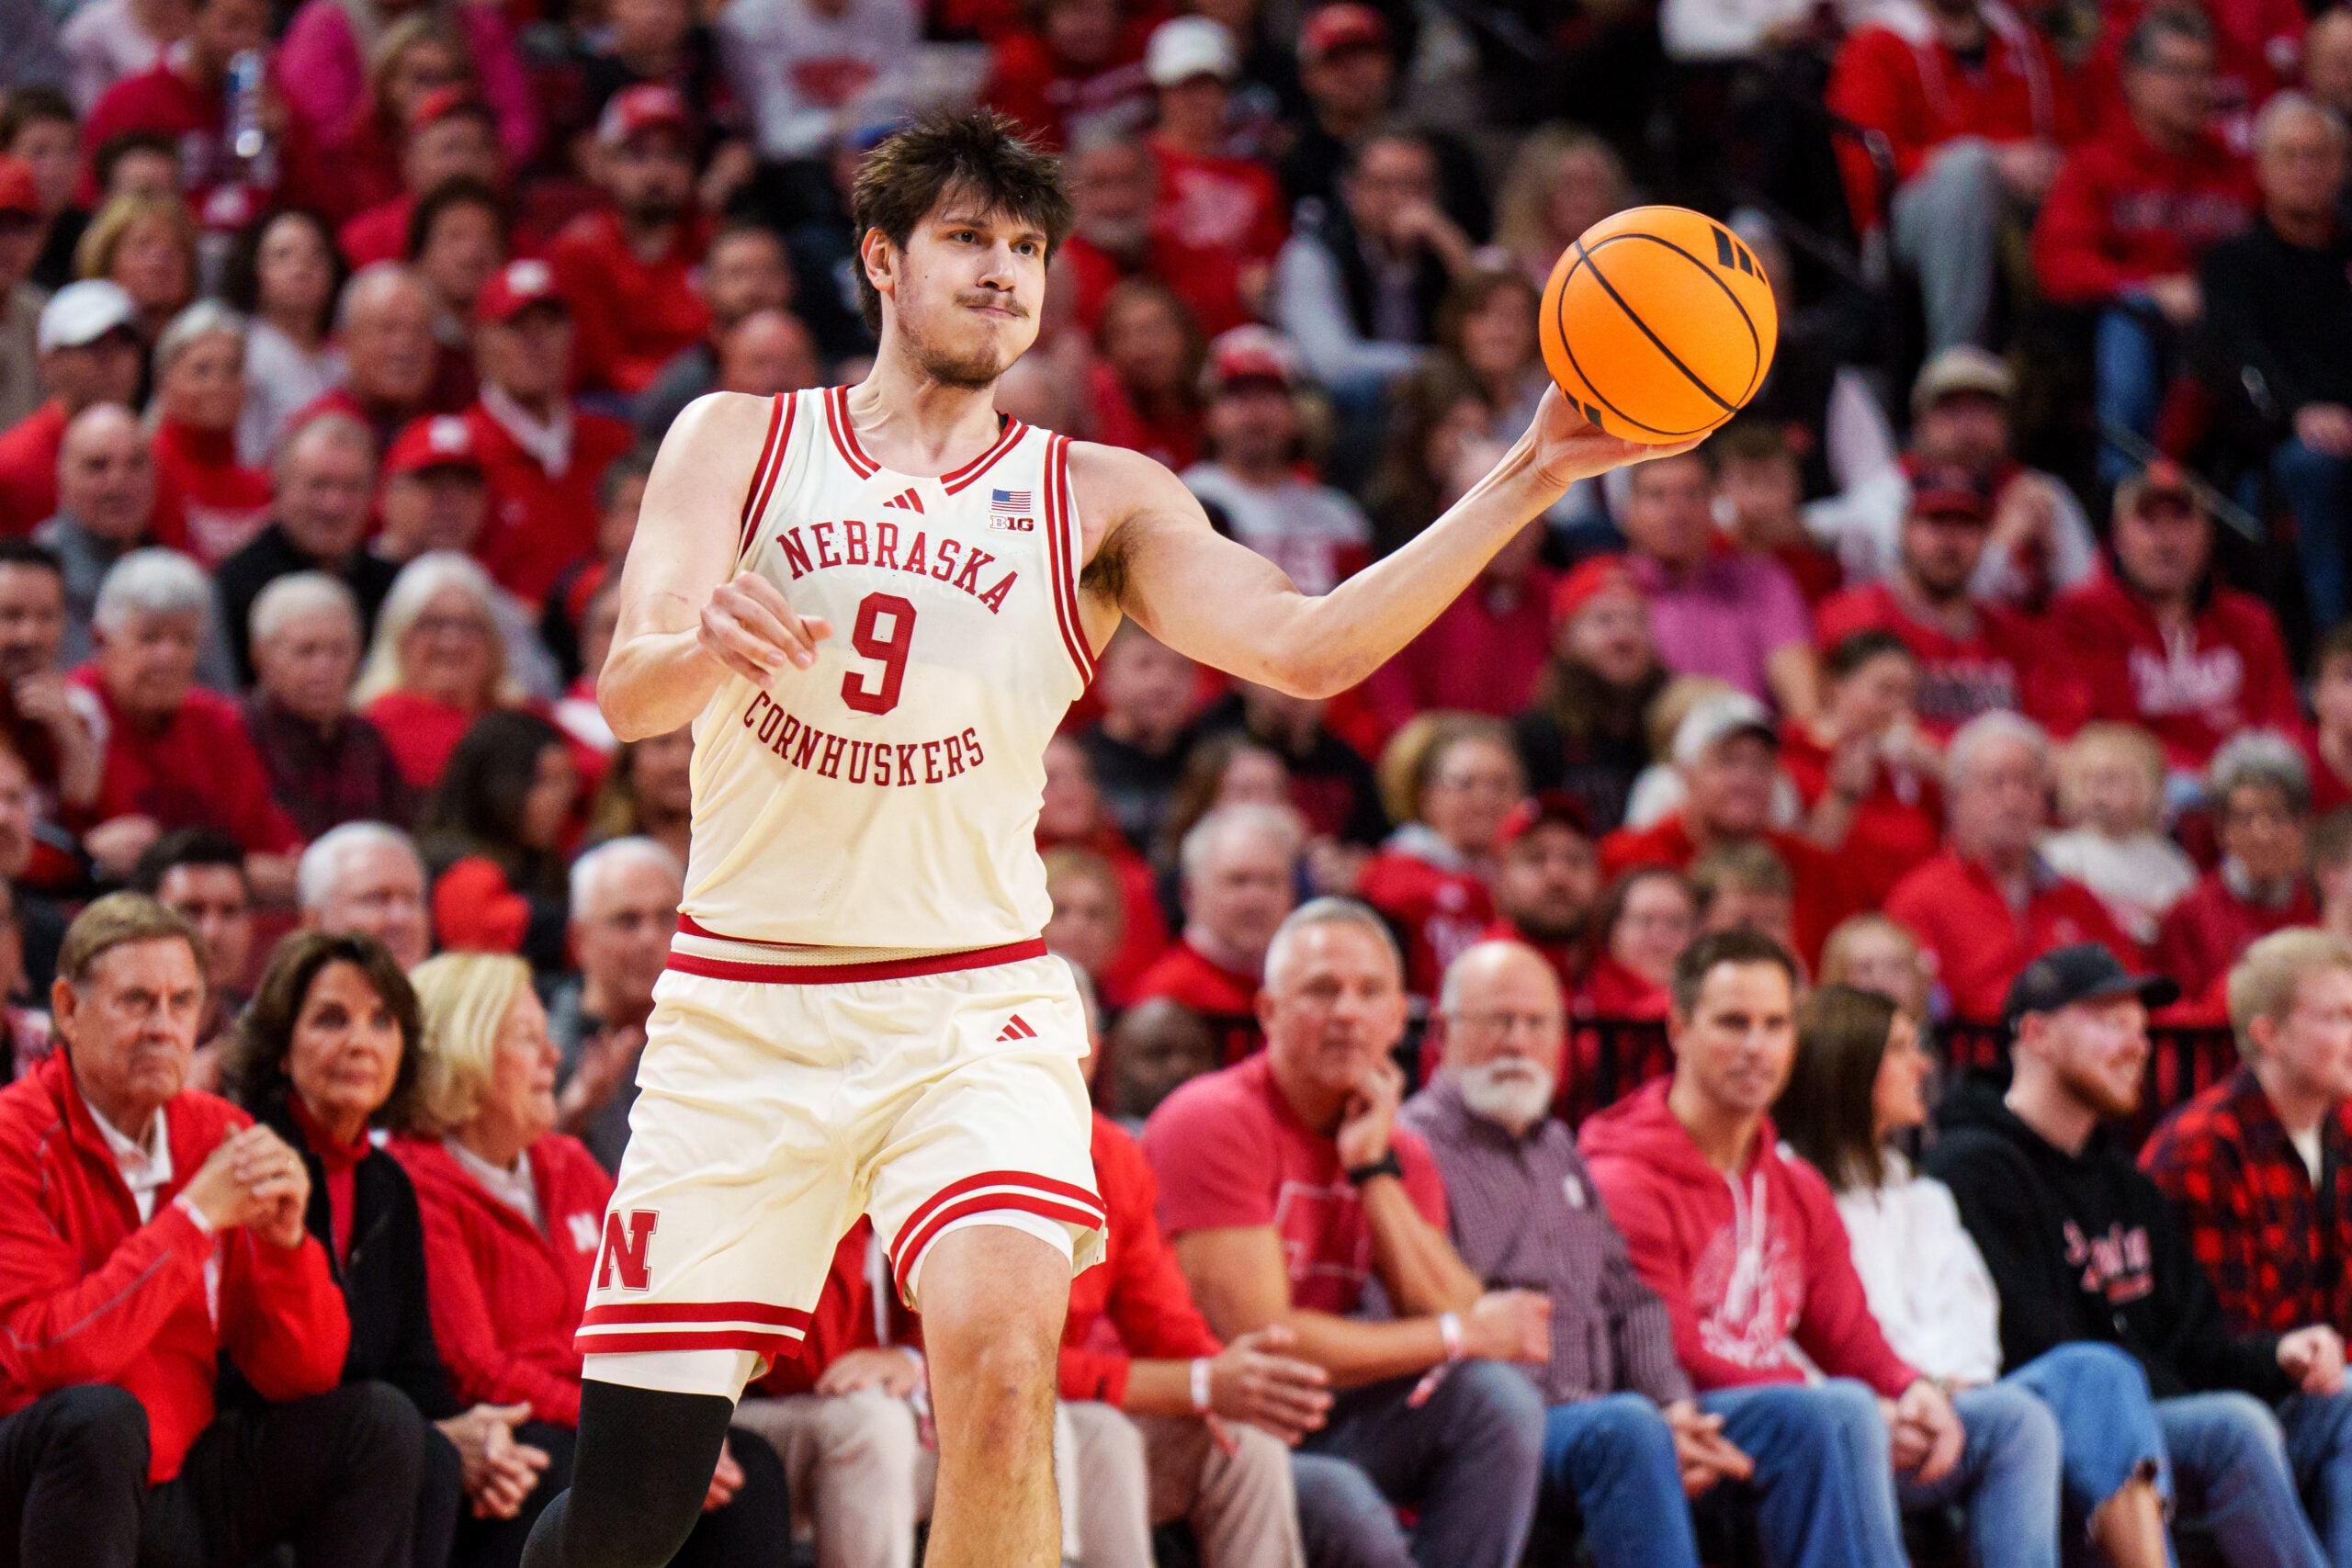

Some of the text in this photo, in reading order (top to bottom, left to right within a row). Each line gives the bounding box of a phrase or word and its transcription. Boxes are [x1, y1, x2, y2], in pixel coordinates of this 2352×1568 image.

[775, 520, 1018, 615] NEBRASKA
[841, 592, 917, 716] 9
[743, 691, 984, 787] CORNHUSKERS
[596, 1209, 660, 1292] N
